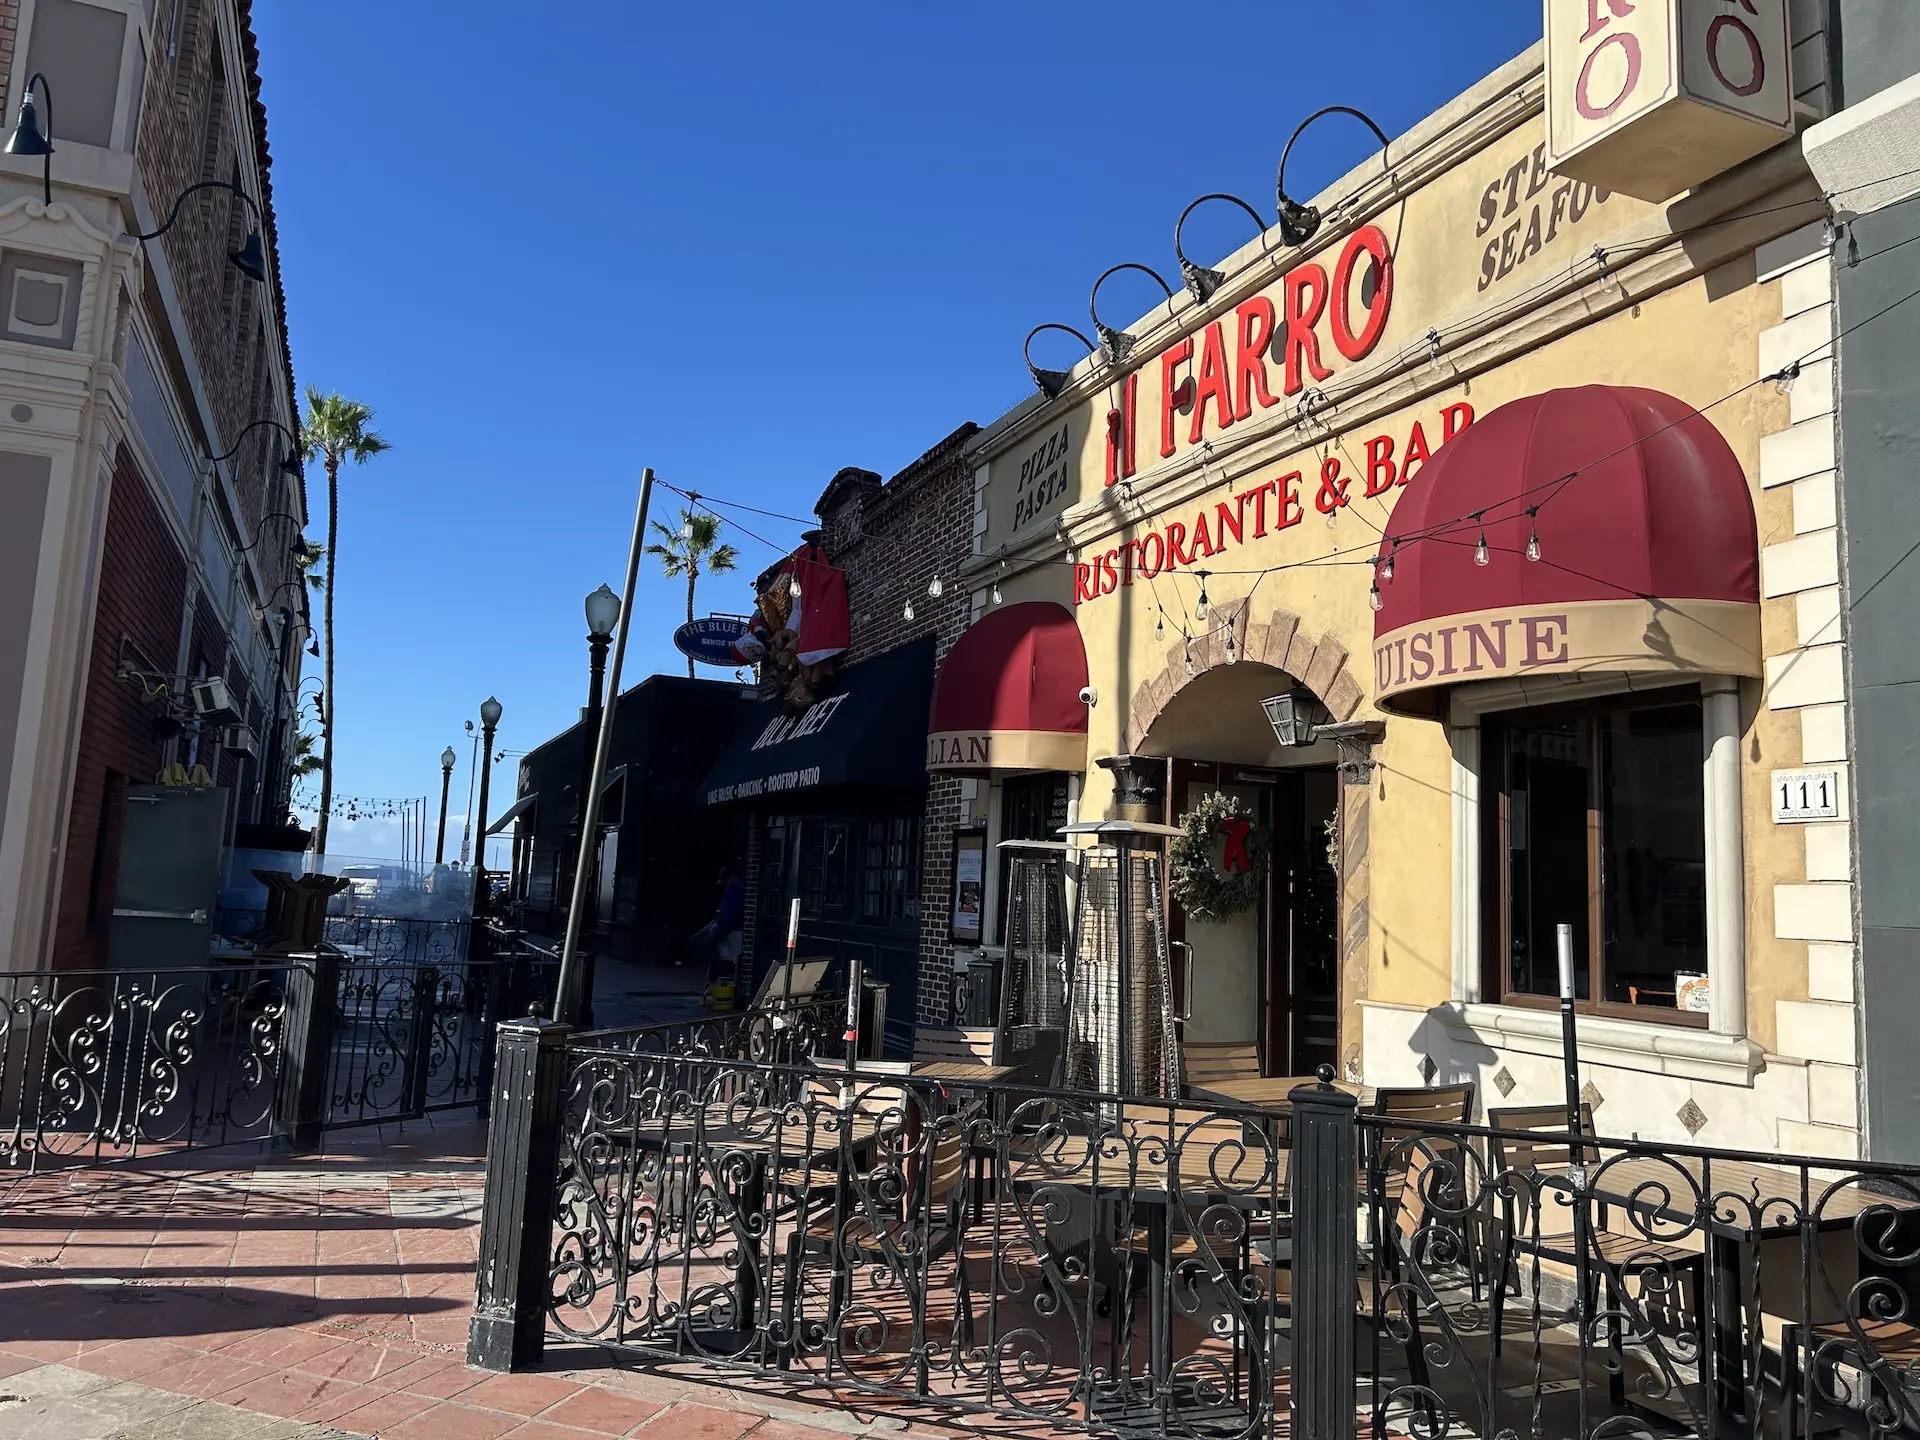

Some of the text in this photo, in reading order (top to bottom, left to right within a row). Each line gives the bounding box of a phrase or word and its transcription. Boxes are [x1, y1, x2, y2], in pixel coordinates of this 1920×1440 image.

[1476, 141, 1556, 238] STE
[1159, 225, 1393, 459] FARRO
[1017, 422, 1069, 494] PIZZA
[1013, 461, 1068, 532] PASTA
[1072, 471, 1304, 606] RISTORANTE
[1315, 457, 1351, 514] &
[681, 622, 706, 637] THE
[708, 621, 738, 634] BLUE
[701, 637, 726, 647] SINCE
[1375, 614, 1568, 692] UISINE
[737, 778, 763, 799] DANCING
[767, 770, 798, 792] ROOFTOP
[799, 765, 820, 787] PATIO
[930, 736, 992, 765] LIAN
[1780, 781, 1830, 810] 111
